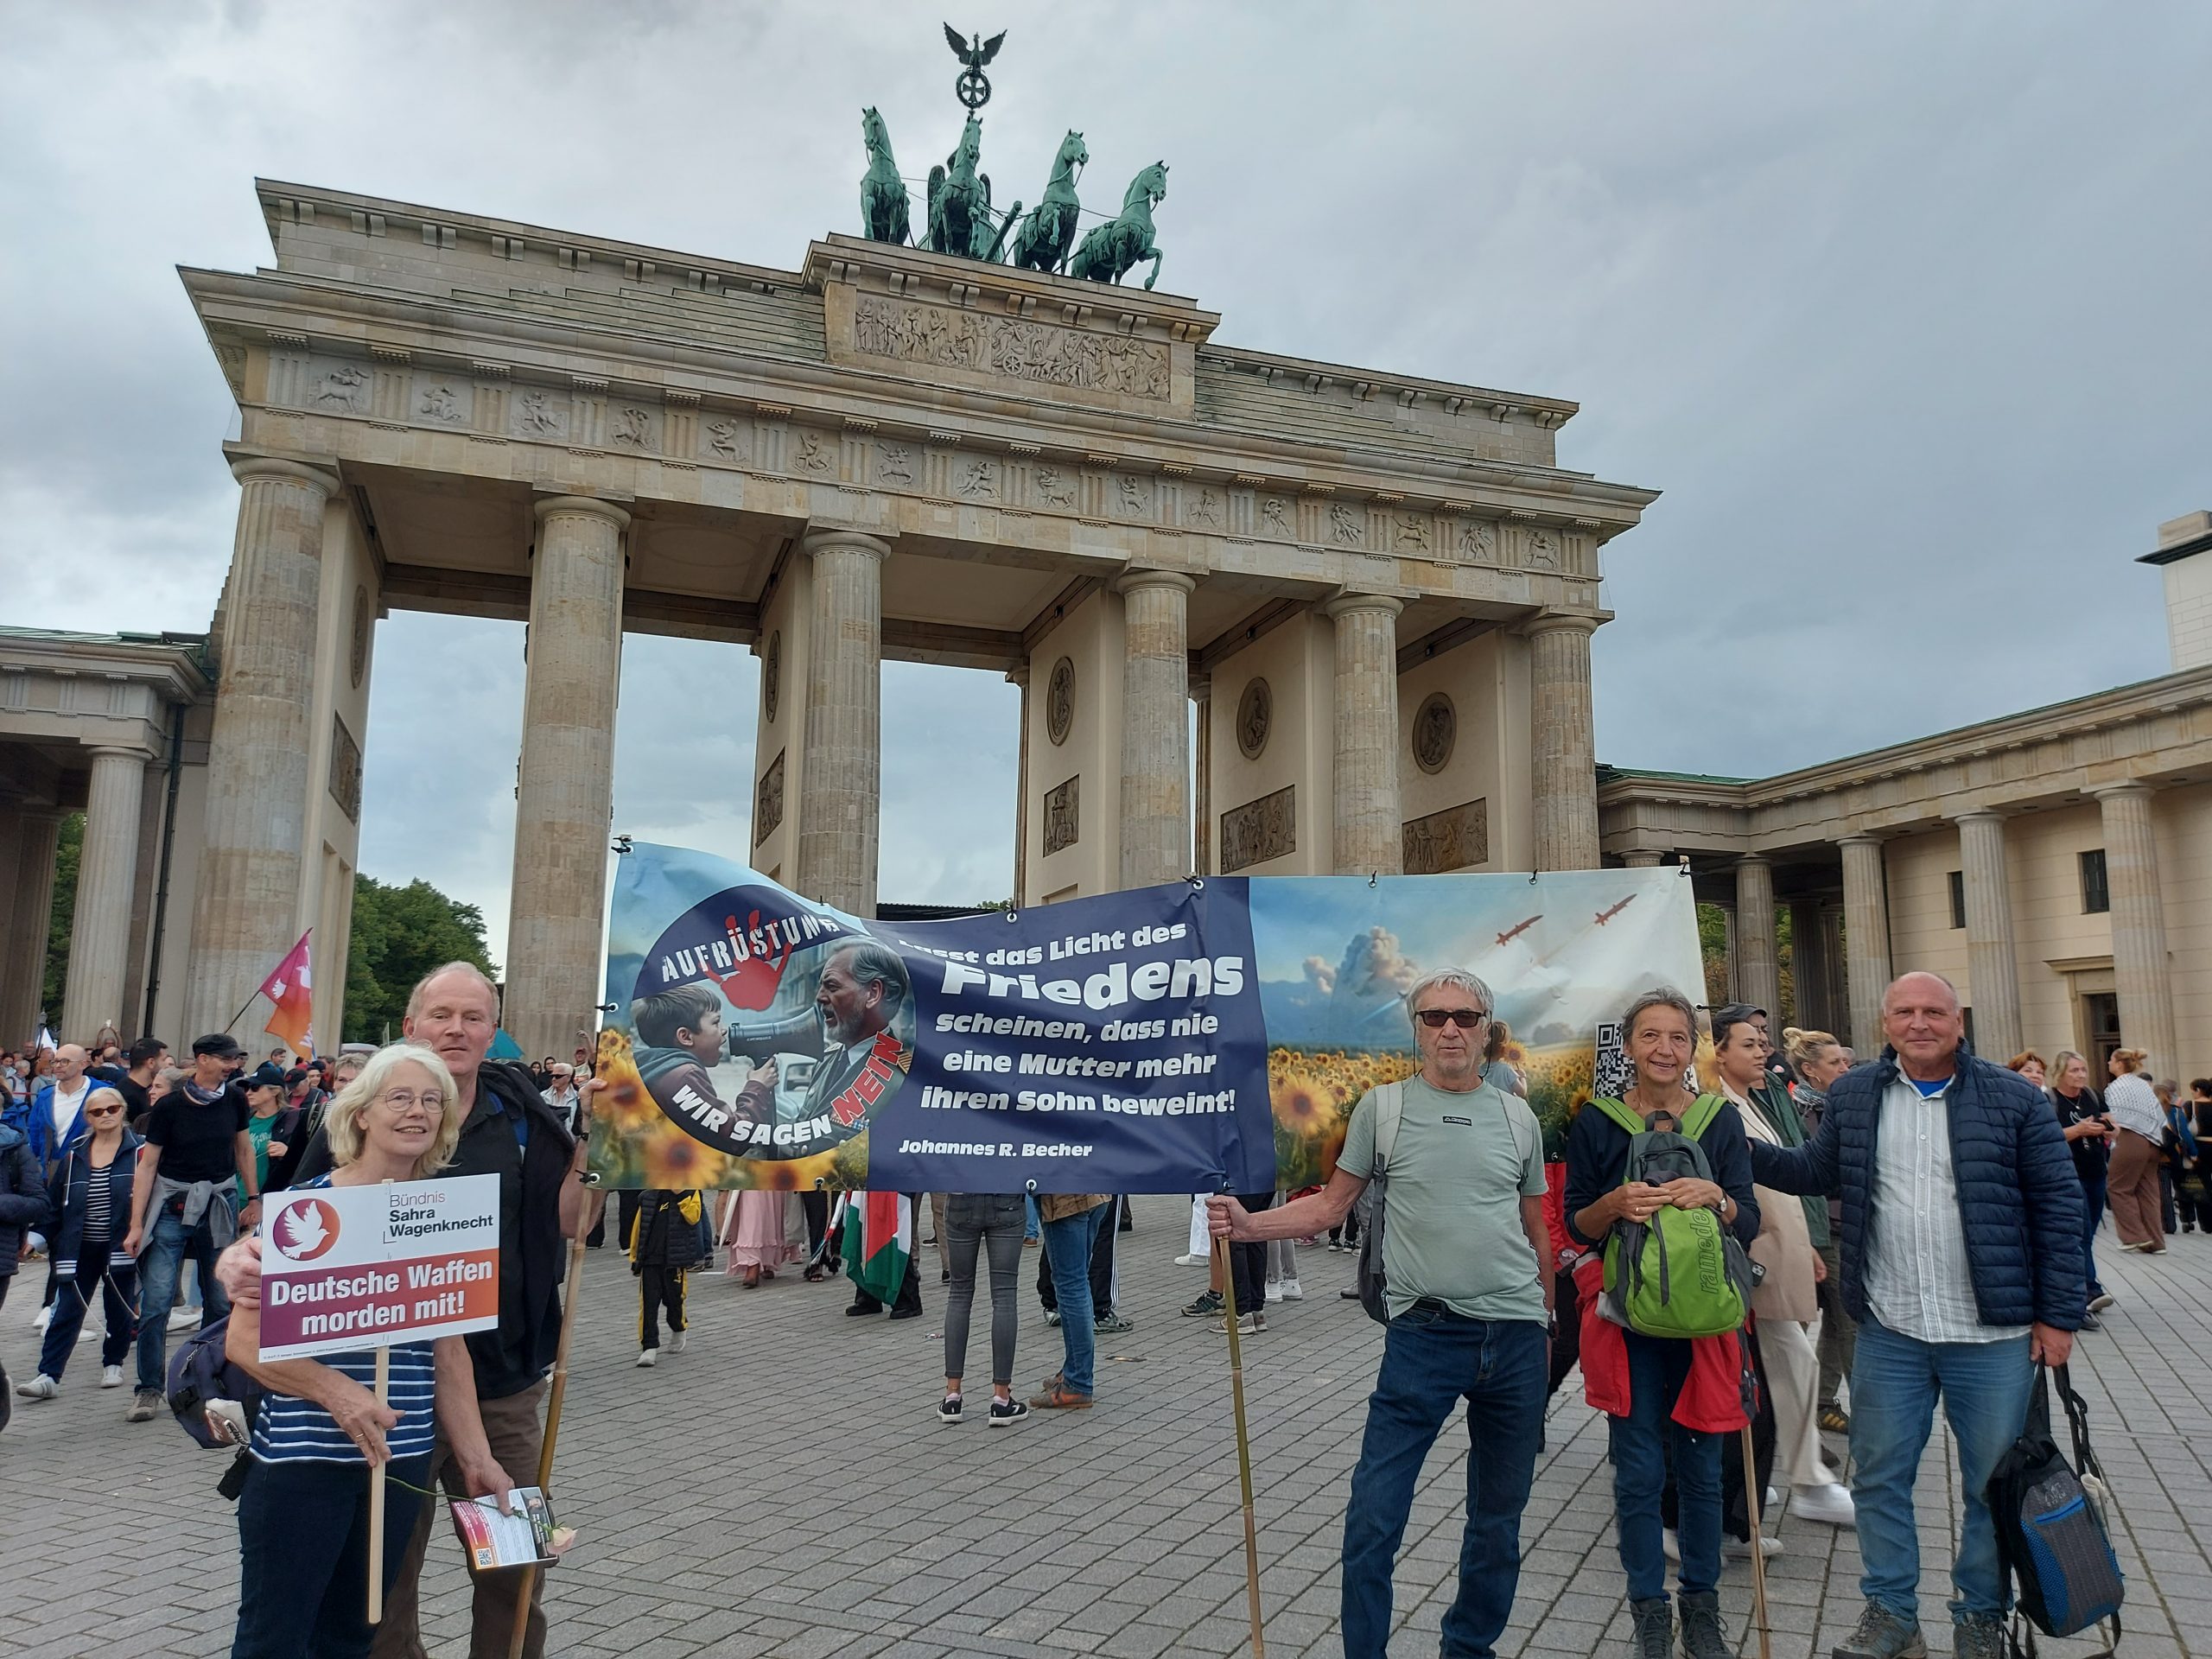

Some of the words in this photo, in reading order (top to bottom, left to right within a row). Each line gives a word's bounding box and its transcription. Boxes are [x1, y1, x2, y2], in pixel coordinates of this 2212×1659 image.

[986, 946, 1042, 966] das
[1050, 930, 1125, 961] Licht
[1132, 923, 1187, 947] des
[941, 956, 1243, 1010] Friedens
[935, 1012, 1091, 1044] scheinen,
[1100, 1016, 1166, 1042] dass
[1170, 1013, 1218, 1036] nie
[943, 1050, 1012, 1073] eine
[1018, 1053, 1130, 1078] Mutter
[1135, 1052, 1217, 1078] mehr
[671, 1084, 728, 1133] WIR
[730, 1114, 832, 1146] SAGEN
[830, 1030, 903, 1127] NEIN
[920, 1085, 1009, 1110] ihren
[1016, 1090, 1096, 1111] Sohn
[1103, 1089, 1236, 1116] beweint!
[899, 1139, 996, 1156] Johannes
[999, 1143, 1017, 1157] R.
[1021, 1143, 1093, 1157] Becher
[390, 1191, 446, 1207] Bündnis
[389, 1208, 435, 1223] Sahra
[390, 1214, 494, 1237] Wagenknecht
[1689, 1208, 1719, 1294] ramede
[270, 1270, 399, 1306] Deutsche
[407, 1259, 493, 1289] Waffen
[302, 1302, 406, 1336] morden
[415, 1290, 465, 1320] mit!
